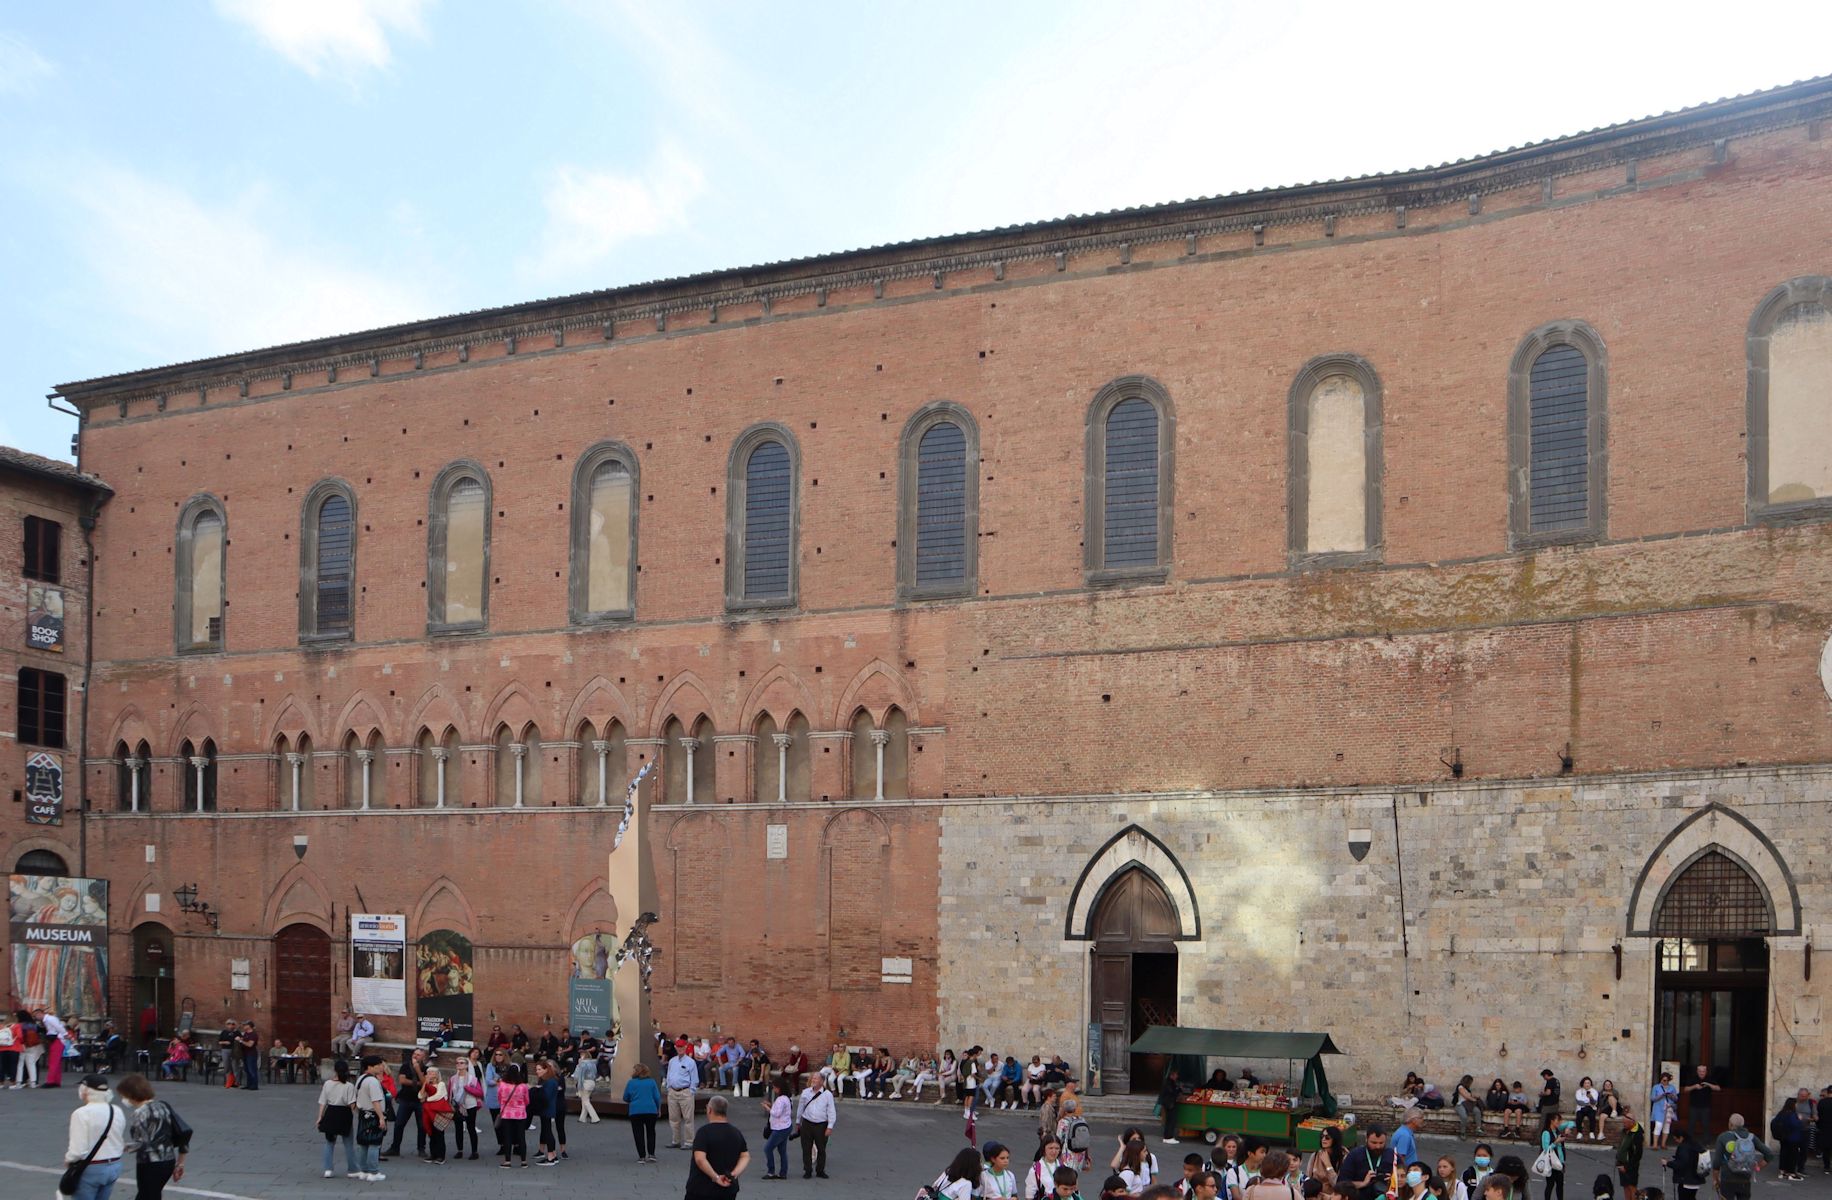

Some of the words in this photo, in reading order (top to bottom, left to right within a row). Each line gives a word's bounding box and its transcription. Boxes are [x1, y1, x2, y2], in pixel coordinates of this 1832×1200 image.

[32, 625, 59, 637] BOOK
[32, 634, 57, 643] SHOP
[26, 928, 92, 941] MUSEUM
